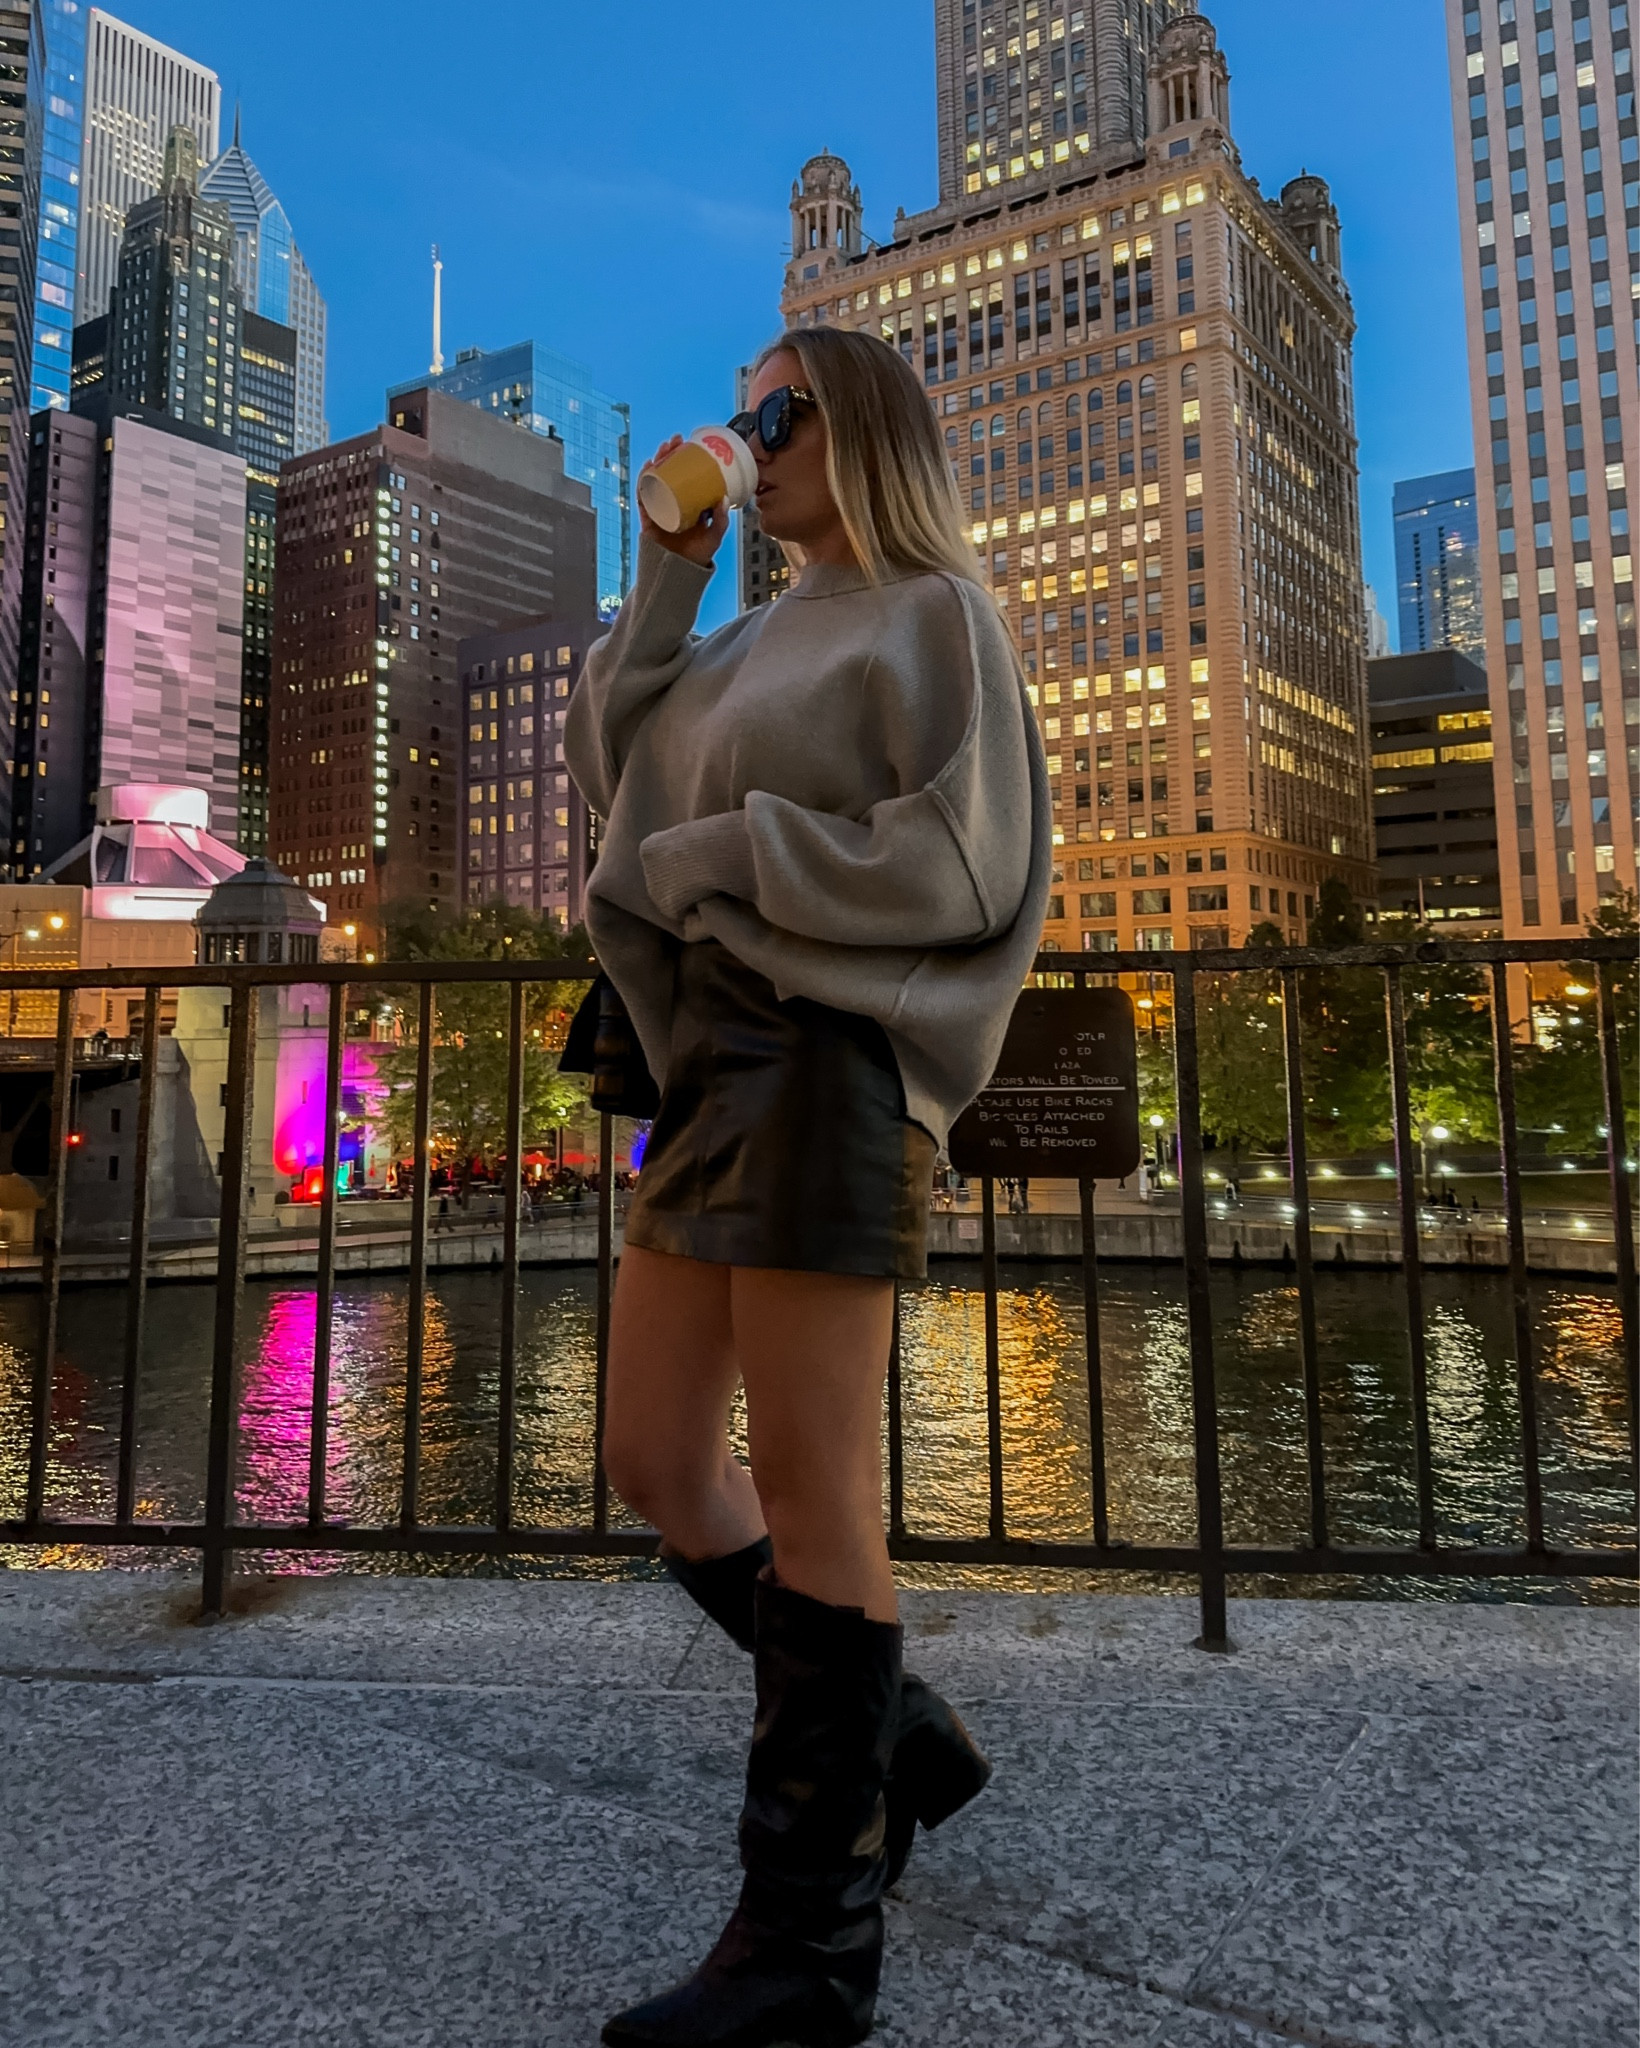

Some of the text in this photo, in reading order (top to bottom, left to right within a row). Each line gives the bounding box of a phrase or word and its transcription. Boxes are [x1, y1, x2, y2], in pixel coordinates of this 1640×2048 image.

[377, 624, 389, 670] THE
[375, 683, 388, 847] STEAKHOUSE
[1027, 1076, 1055, 1086] WILL
[1060, 1075, 1077, 1086] BE
[1080, 1074, 1119, 1085] TOWED
[1016, 1096, 1040, 1107] USE
[1044, 1096, 1072, 1107] BIKE
[1075, 1096, 1114, 1107] RACKS
[979, 1111, 1105, 1122] BICCLES ATTACHED
[1013, 1124, 1070, 1135] TO RAILS
[1020, 1137, 1037, 1147] BE
[1041, 1137, 1097, 1147] REMOVED
